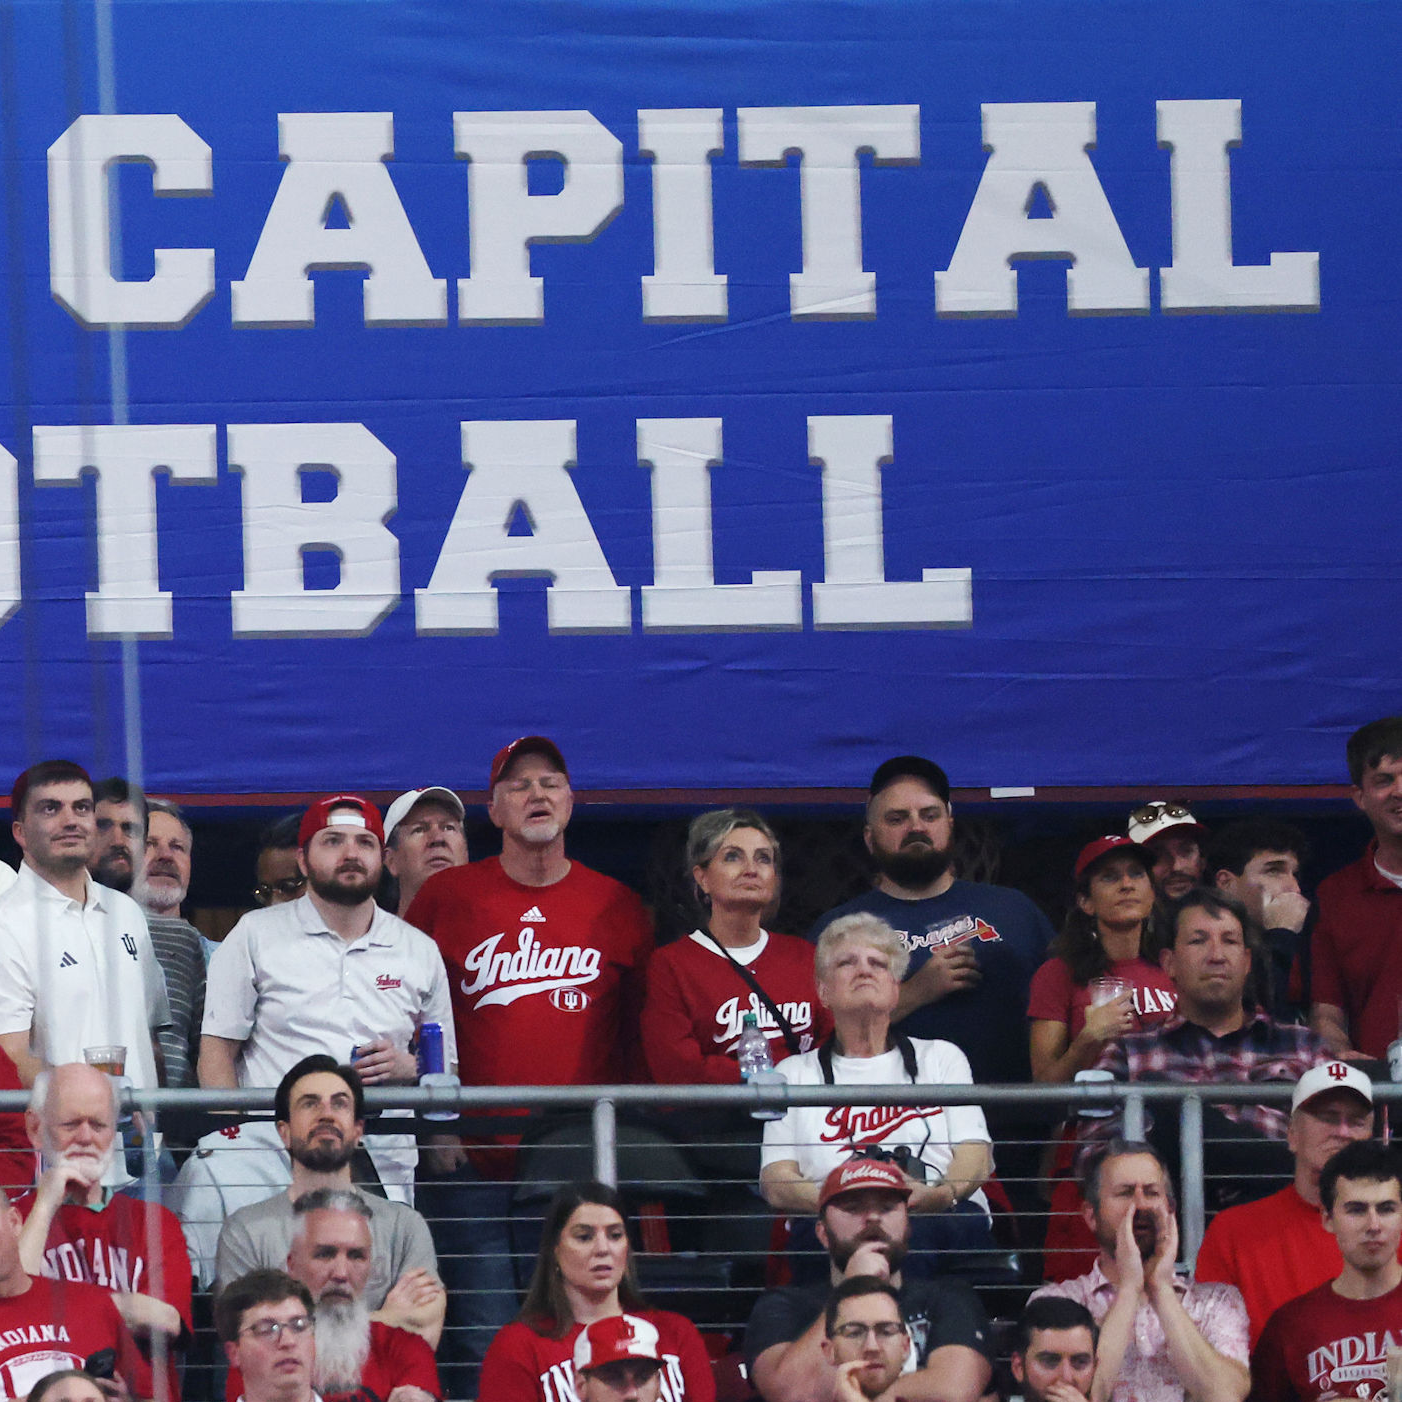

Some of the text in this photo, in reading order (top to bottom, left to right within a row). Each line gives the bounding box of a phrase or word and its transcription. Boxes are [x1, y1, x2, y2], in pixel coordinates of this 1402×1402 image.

[47, 99, 1322, 332] CAPITAL
[460, 927, 602, 995] Indiana
[38, 1236, 145, 1296] NDIANA
[1307, 1329, 1402, 1383] INDIA
